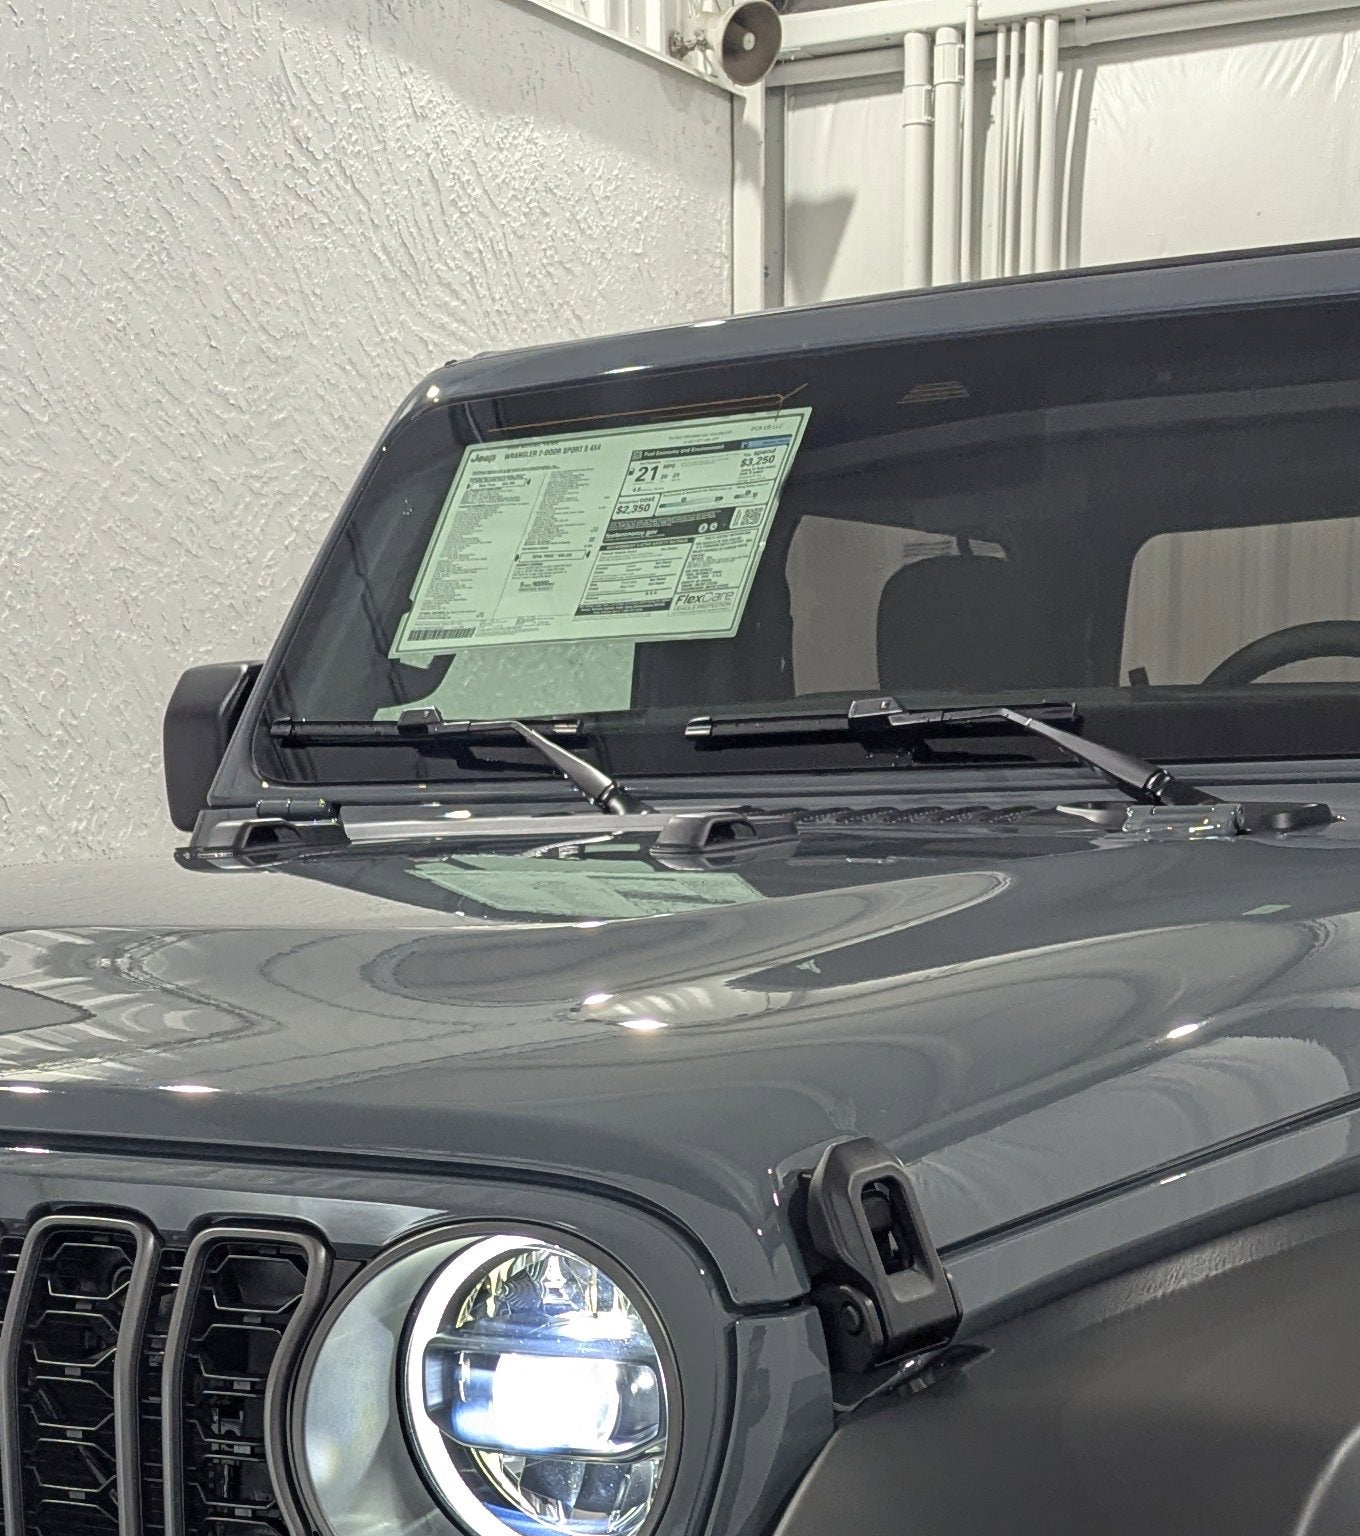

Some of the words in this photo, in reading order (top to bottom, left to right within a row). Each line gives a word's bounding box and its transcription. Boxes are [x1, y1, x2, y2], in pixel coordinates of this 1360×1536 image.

[470, 453, 497, 464] Jeep
[504, 449, 538, 460] WRANGLER
[562, 444, 583, 455] SPORT
[740, 454, 776, 468] $3,250
[634, 464, 659, 483] 21
[615, 503, 651, 515] $2,350
[675, 591, 735, 606] FlexCare
